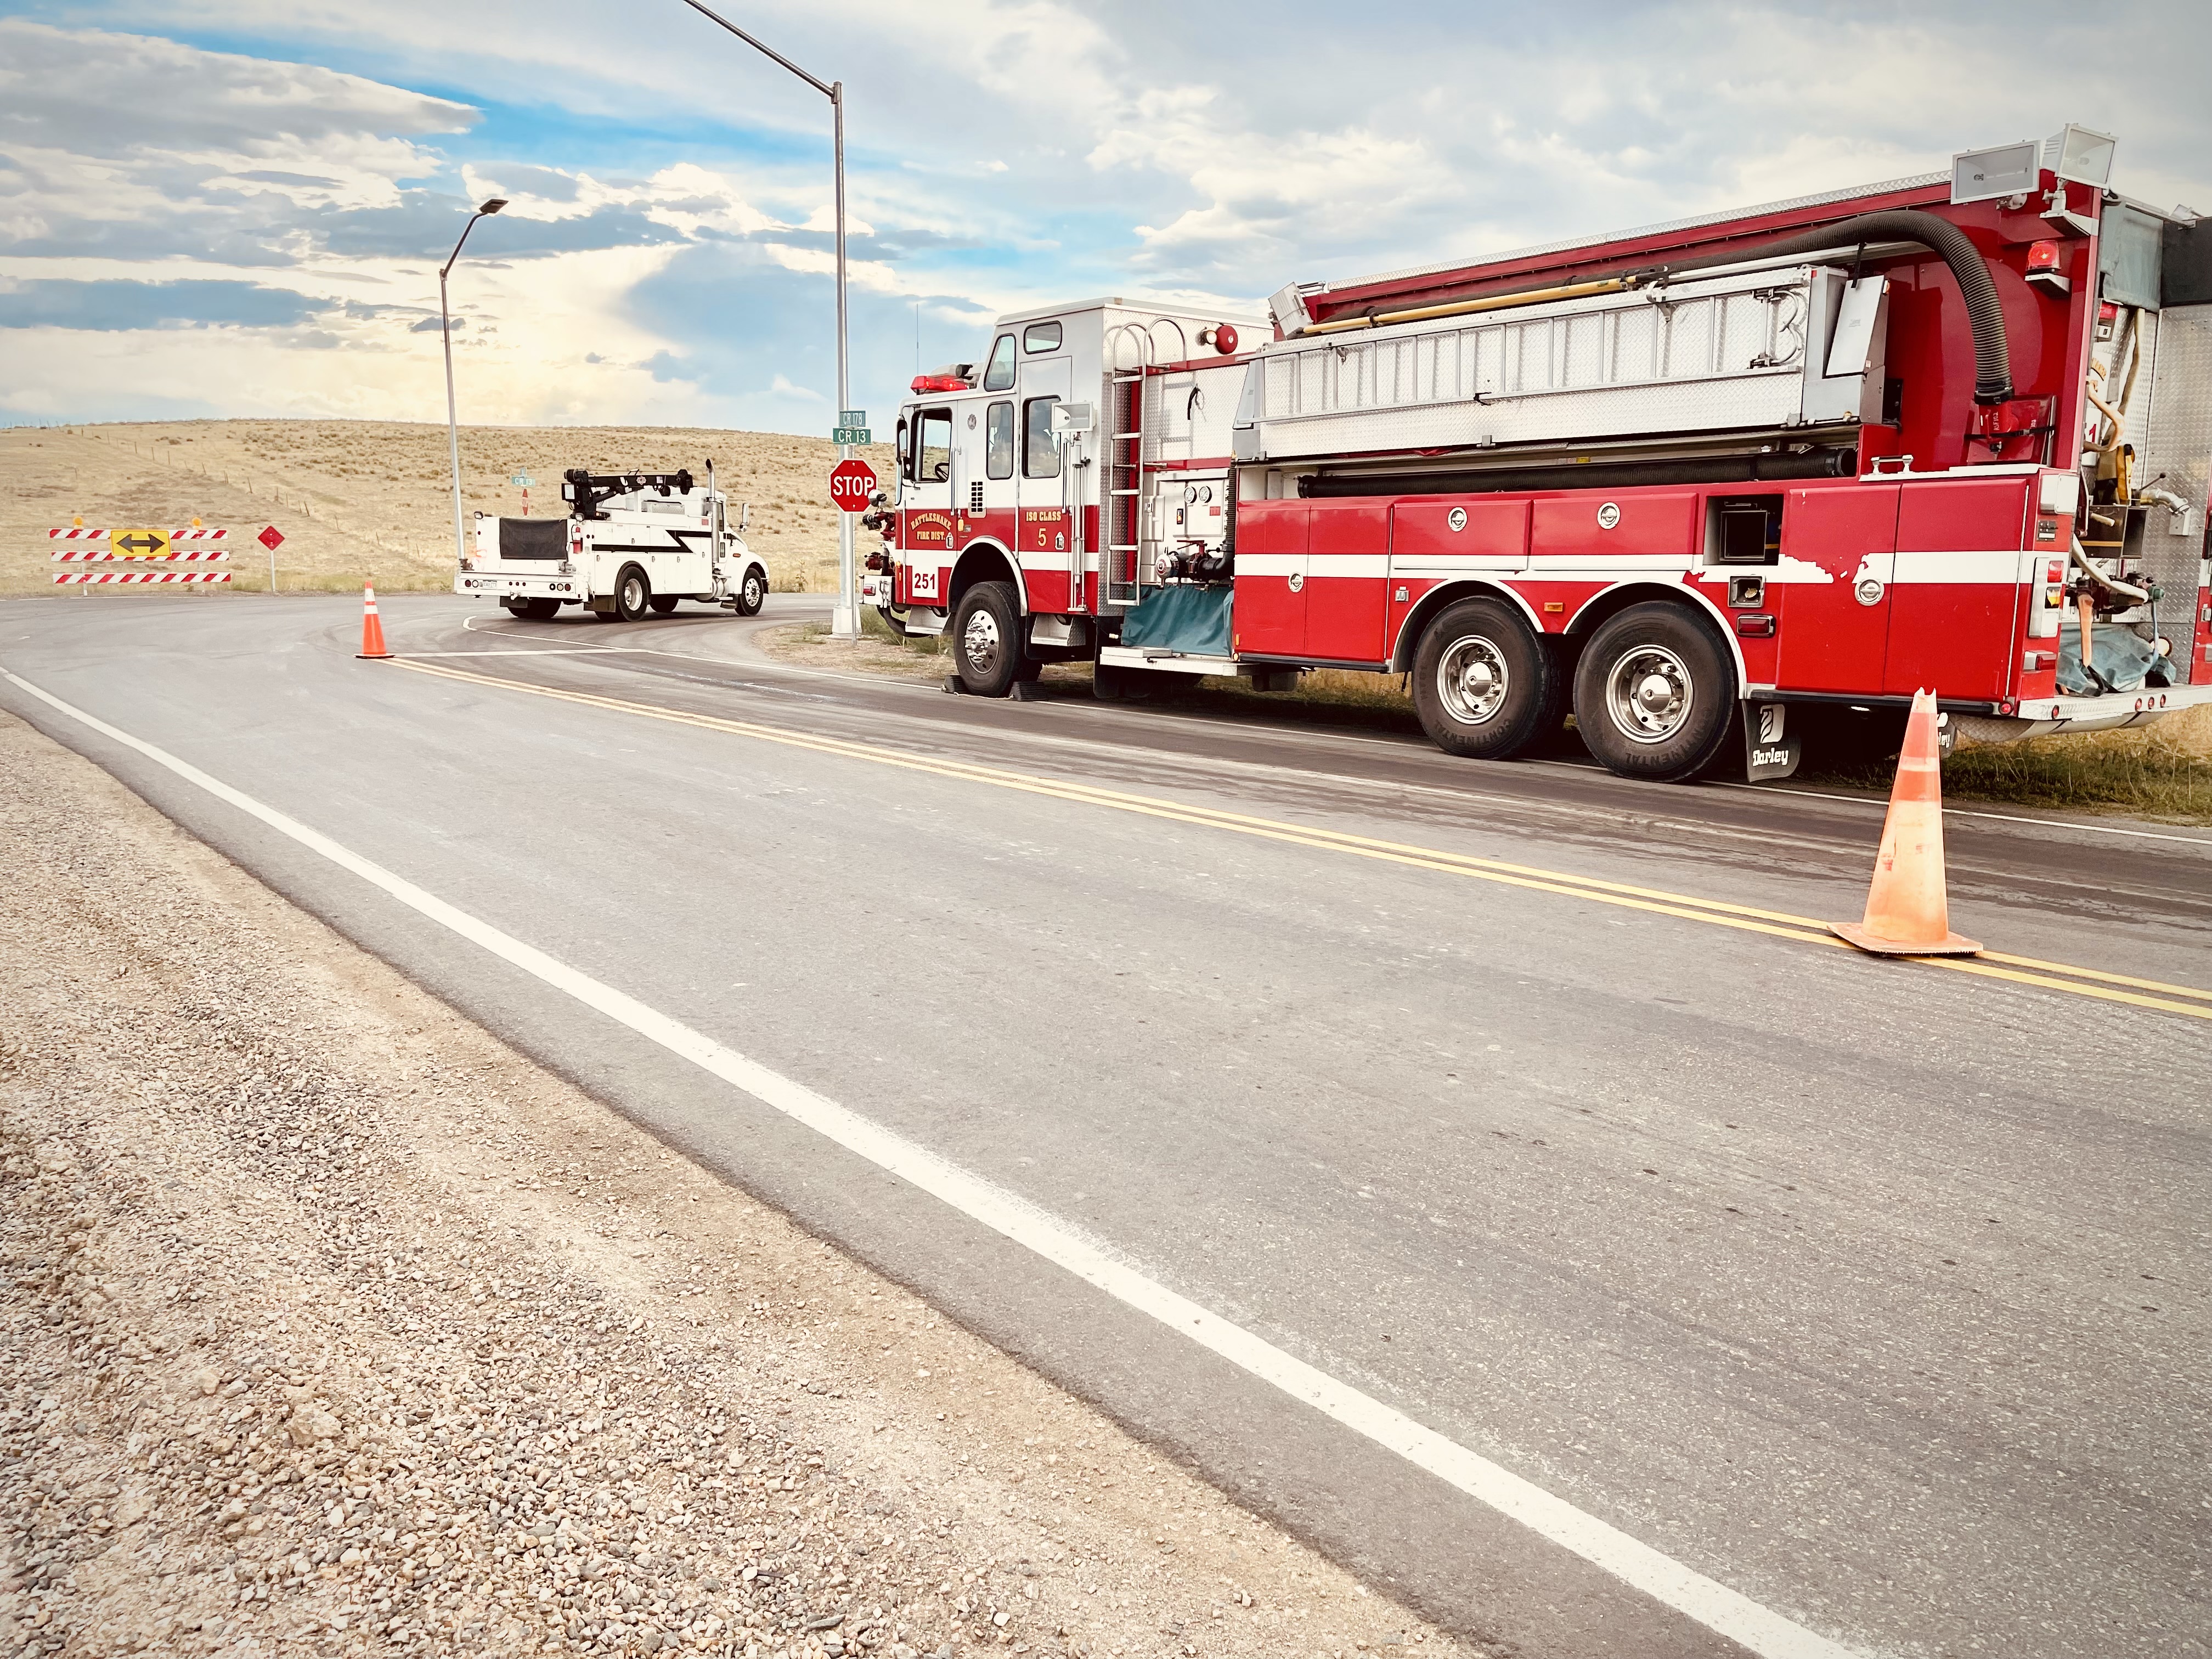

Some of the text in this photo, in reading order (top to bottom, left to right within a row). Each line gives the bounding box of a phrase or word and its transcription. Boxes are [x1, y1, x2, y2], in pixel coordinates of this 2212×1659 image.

[843, 412, 862, 425] CR 178
[838, 430, 866, 443] CR 13
[833, 476, 874, 496] STOP
[910, 512, 952, 531] RATTLESNAKE
[1026, 511, 1061, 521] ISO CLASS
[917, 531, 946, 540] FIRE DIST.
[1037, 528, 1046, 546] 5
[914, 573, 935, 589] 251
[1752, 747, 1788, 766] Darley
